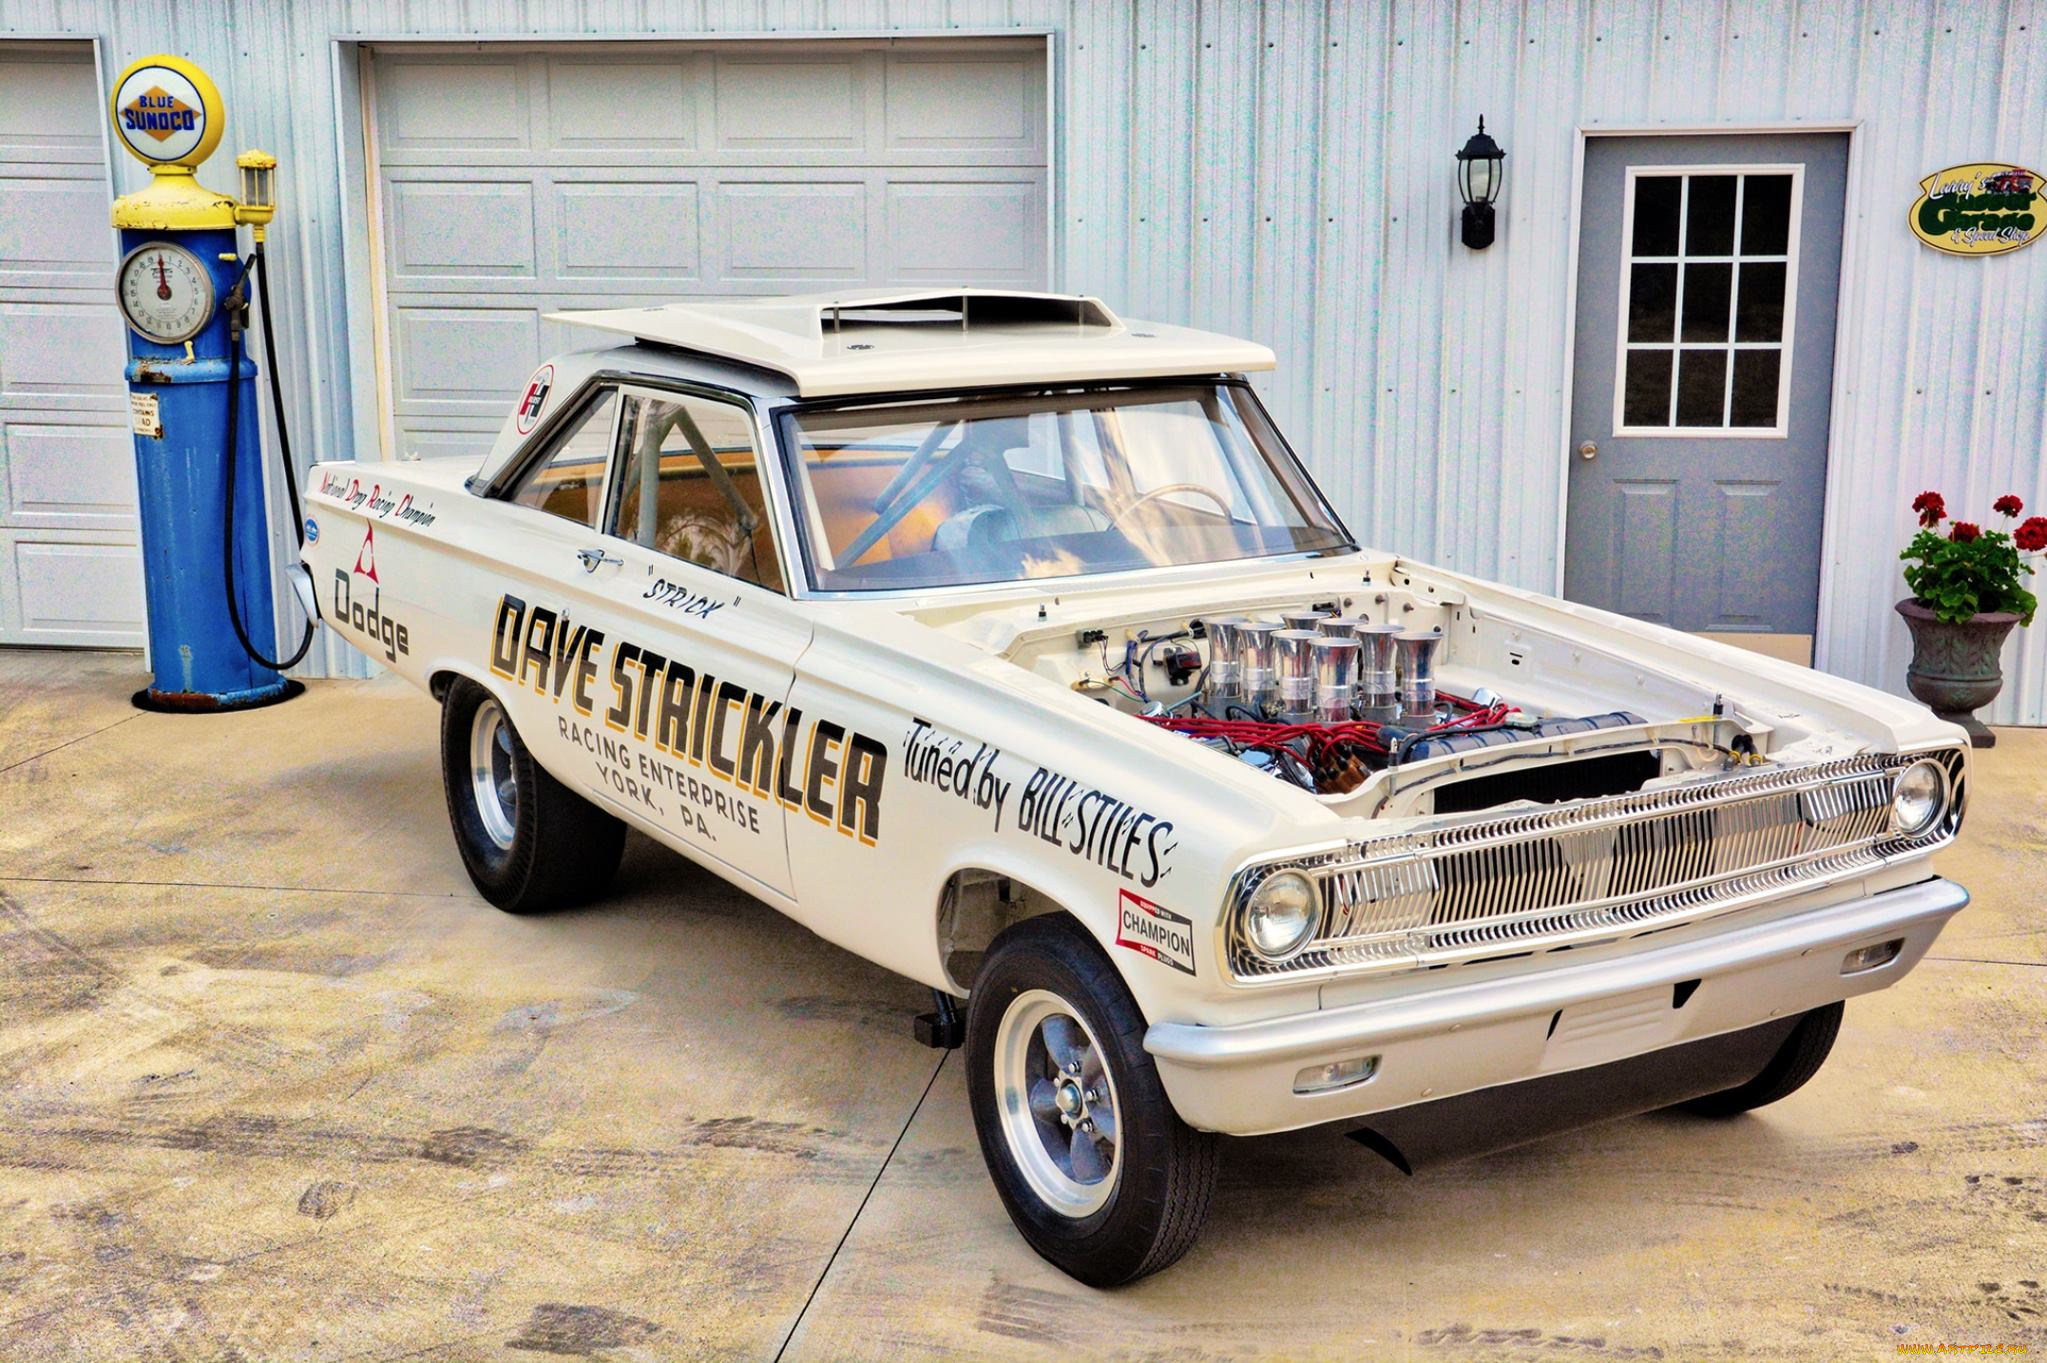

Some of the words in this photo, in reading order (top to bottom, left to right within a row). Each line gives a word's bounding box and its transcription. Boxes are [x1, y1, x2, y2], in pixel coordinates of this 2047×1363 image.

[124, 107, 195, 131] SUNOCO
[139, 95, 174, 108] BLUE
[1929, 171, 1988, 200] Larry's
[1961, 226, 2000, 248] Speed
[1999, 225, 2030, 247] Shop
[345, 479, 368, 510] Drag
[367, 484, 396, 518] Racing
[395, 493, 436, 527] Champion
[335, 568, 410, 663] Dodge
[489, 593, 605, 718] DAVE
[605, 640, 889, 848] STRICKLER
[558, 715, 632, 771] RACING
[640, 755, 761, 836] ENTERPRISE
[595, 761, 666, 817] YORK,
[683, 809, 718, 842] PA.
[903, 717, 988, 801] Tuned
[973, 742, 1012, 833] by
[1018, 766, 1078, 848] BILL
[1069, 789, 1175, 889] STILES
[1123, 910, 1190, 957] CHAMPION
